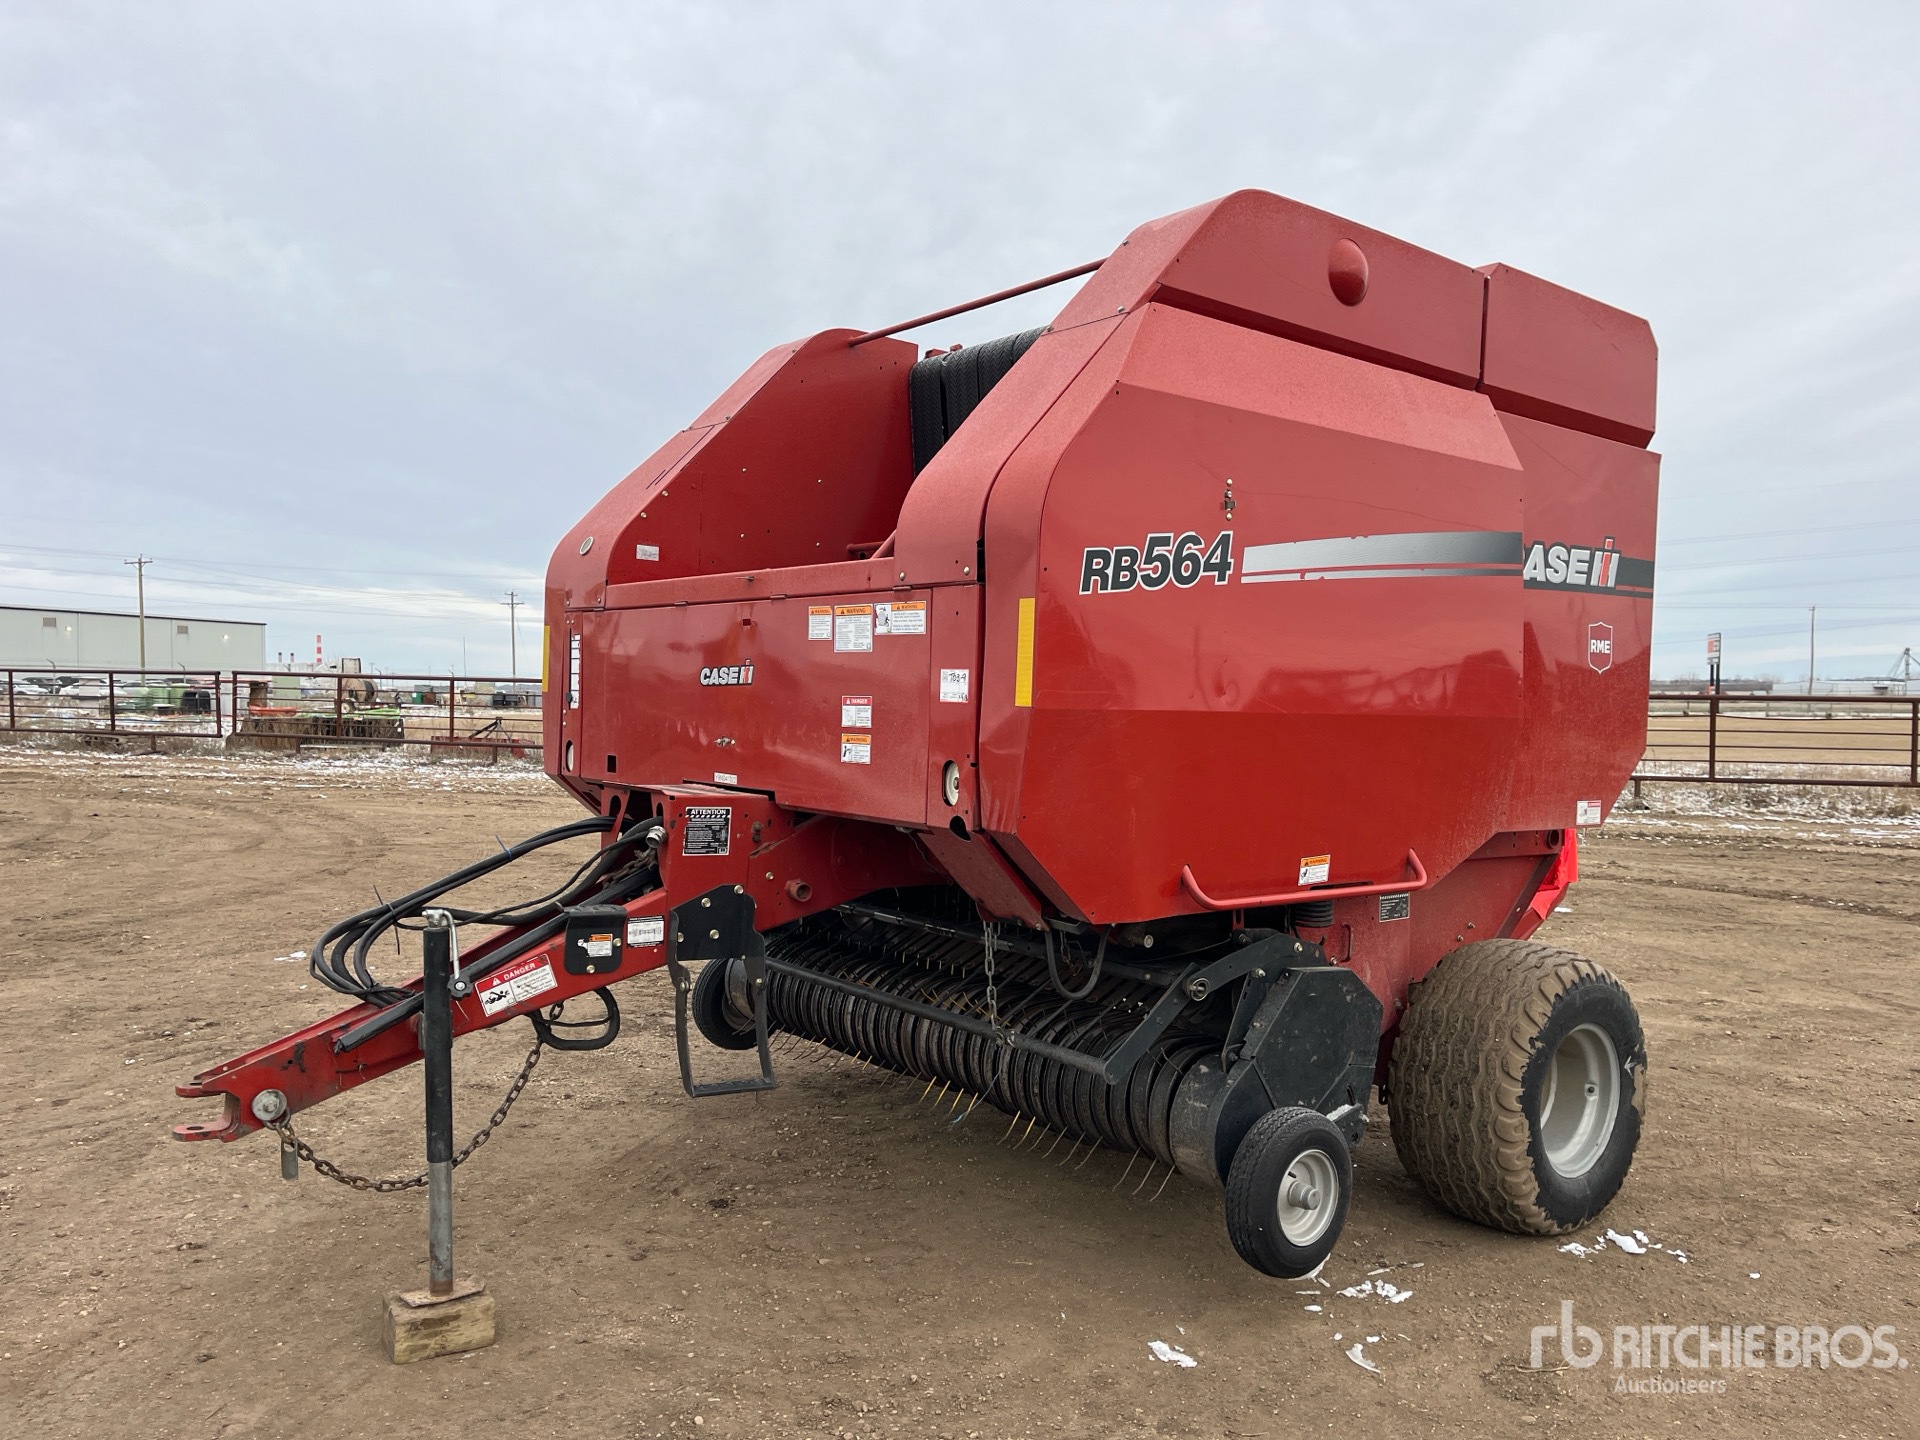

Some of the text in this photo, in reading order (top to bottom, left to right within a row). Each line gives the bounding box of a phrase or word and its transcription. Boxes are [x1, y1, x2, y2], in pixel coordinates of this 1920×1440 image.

[1078, 530, 1235, 595] RB564
[1522, 543, 1591, 585] ASE
[1590, 638, 1611, 655] RME
[700, 666, 740, 686] CASE
[503, 962, 536, 981] DANGER
